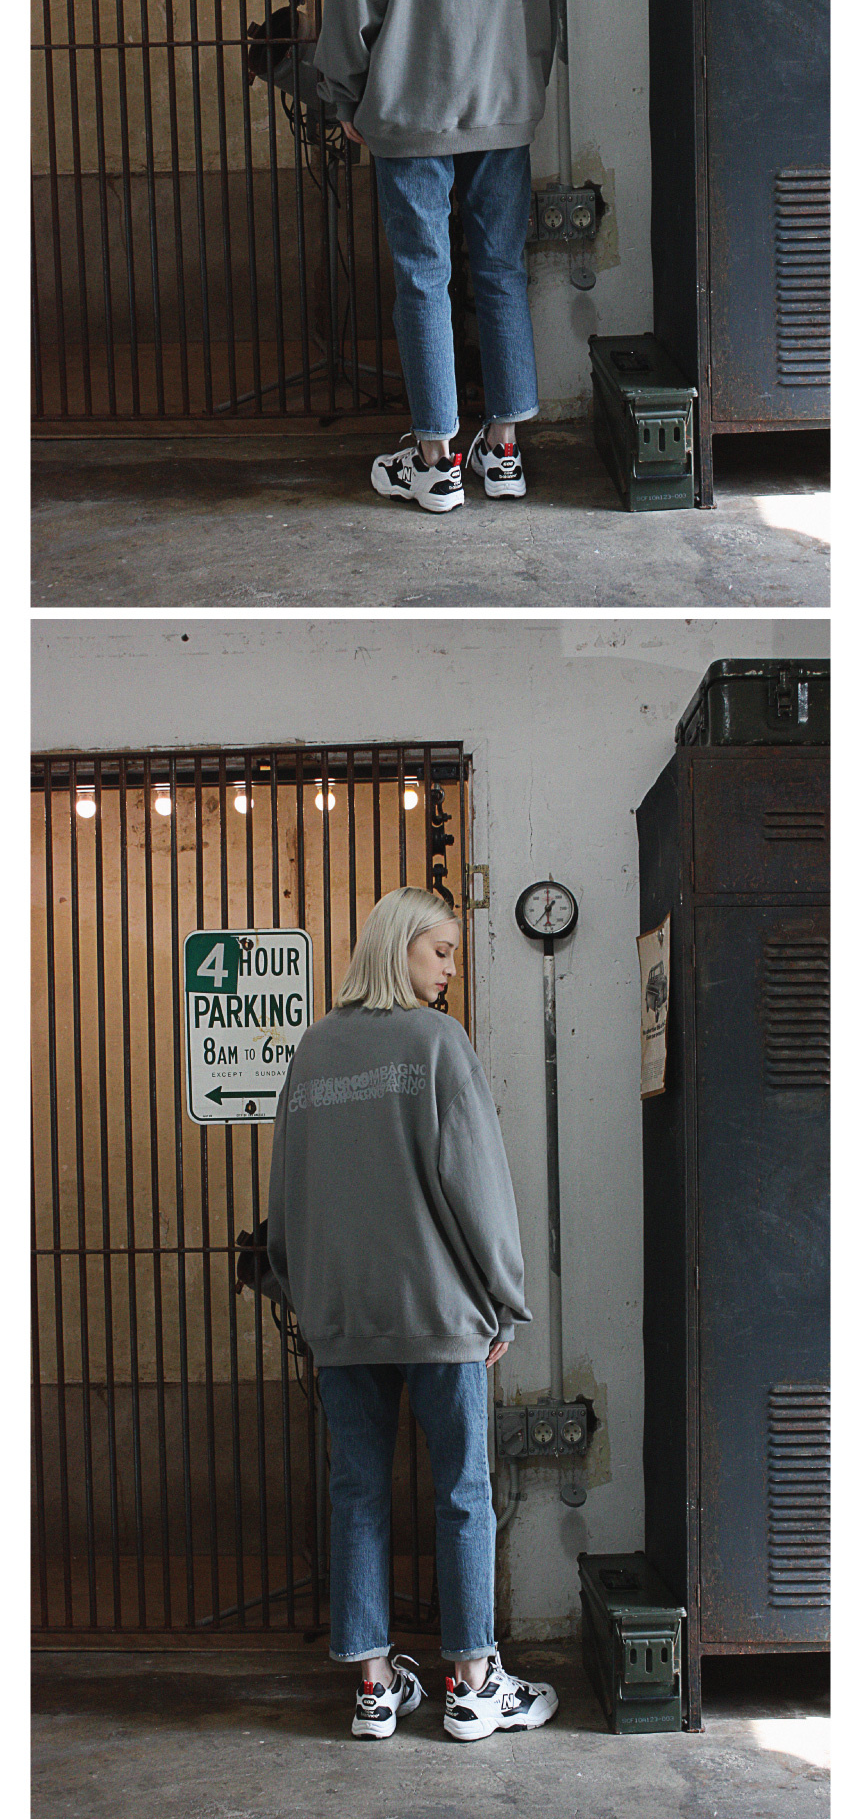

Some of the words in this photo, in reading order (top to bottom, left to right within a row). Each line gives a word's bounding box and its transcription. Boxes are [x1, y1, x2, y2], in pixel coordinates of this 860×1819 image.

[196, 942, 229, 987] 4
[239, 947, 300, 976] HOUR
[194, 993, 303, 1028] PARKING
[203, 1037, 239, 1065] 8AM
[244, 1048, 256, 1060] TO
[261, 1036, 295, 1063] 6PM
